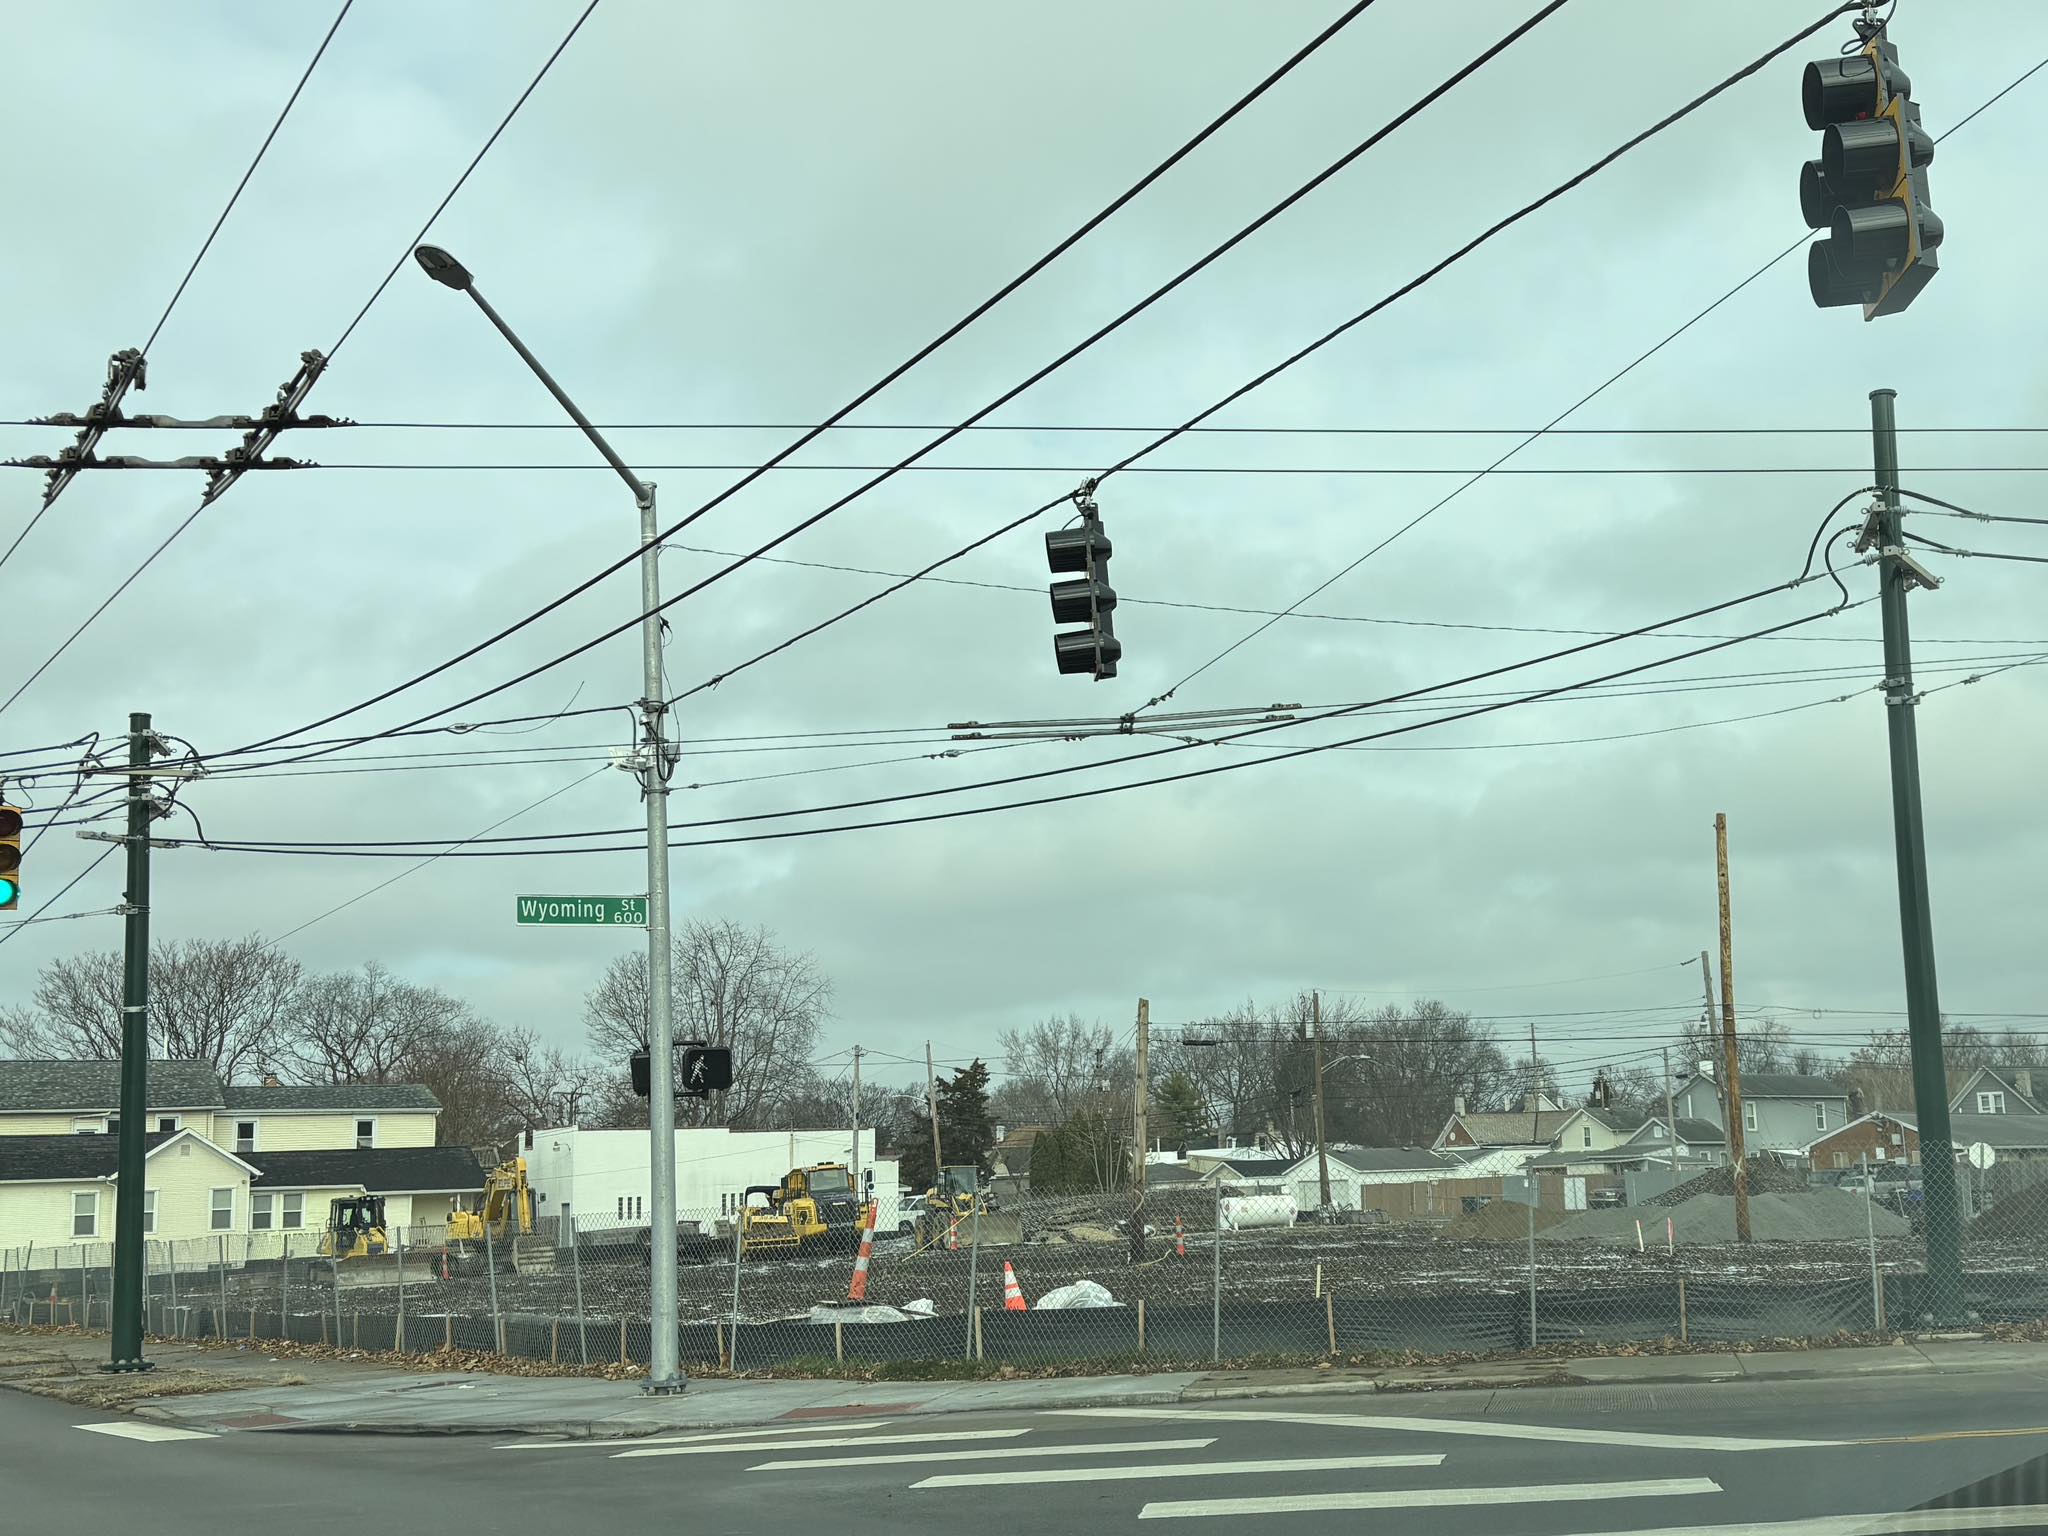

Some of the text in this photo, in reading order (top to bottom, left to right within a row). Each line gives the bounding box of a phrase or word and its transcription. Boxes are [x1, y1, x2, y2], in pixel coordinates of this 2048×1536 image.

[521, 899, 636, 922] Wyoming St
[614, 912, 643, 923] 600
